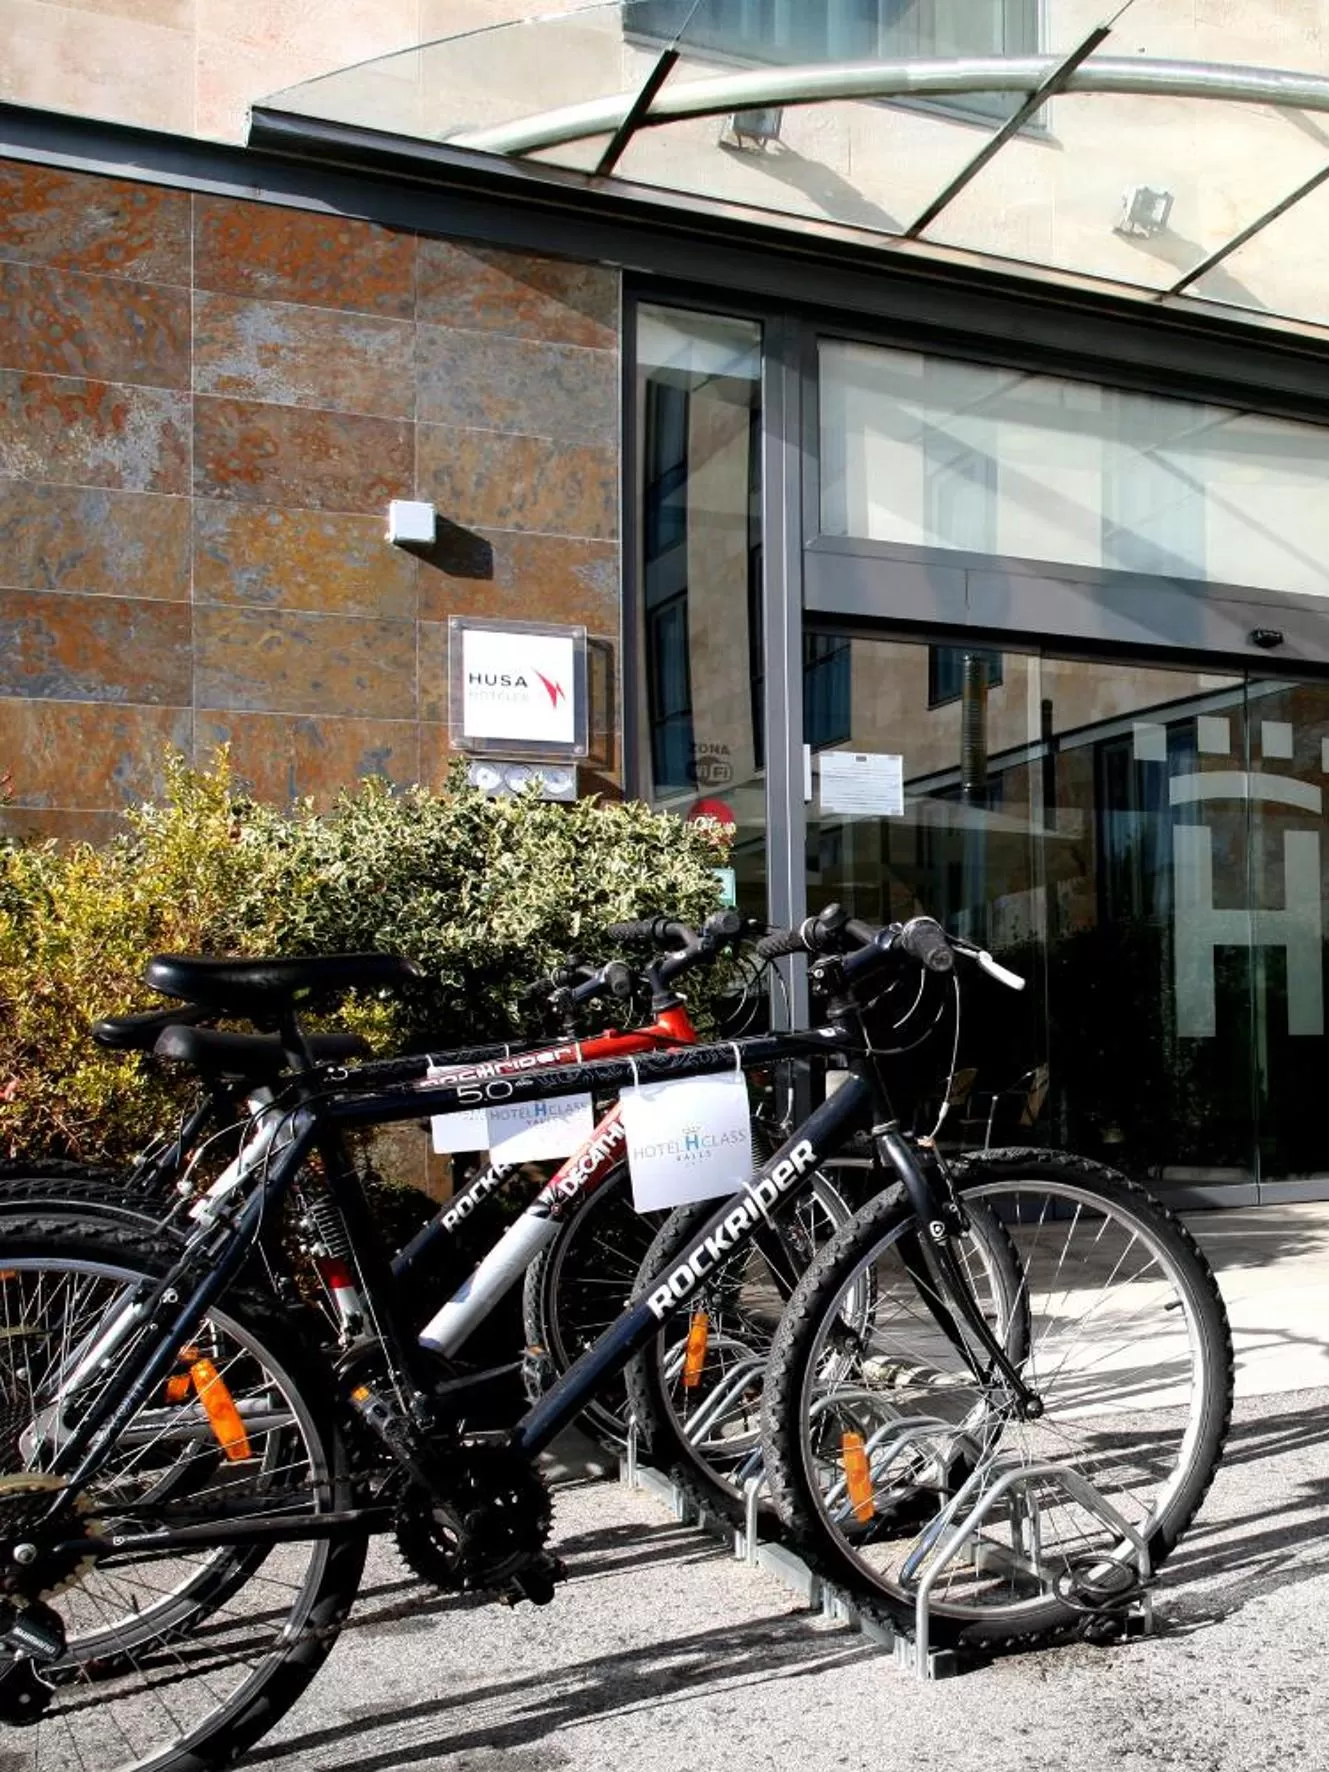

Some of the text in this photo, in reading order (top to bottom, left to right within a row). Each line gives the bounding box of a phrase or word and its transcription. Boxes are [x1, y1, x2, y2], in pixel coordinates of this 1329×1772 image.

[469, 672, 528, 688] HUSA
[634, 1139, 684, 1161] HOTEL
[701, 1127, 748, 1148] CLASS
